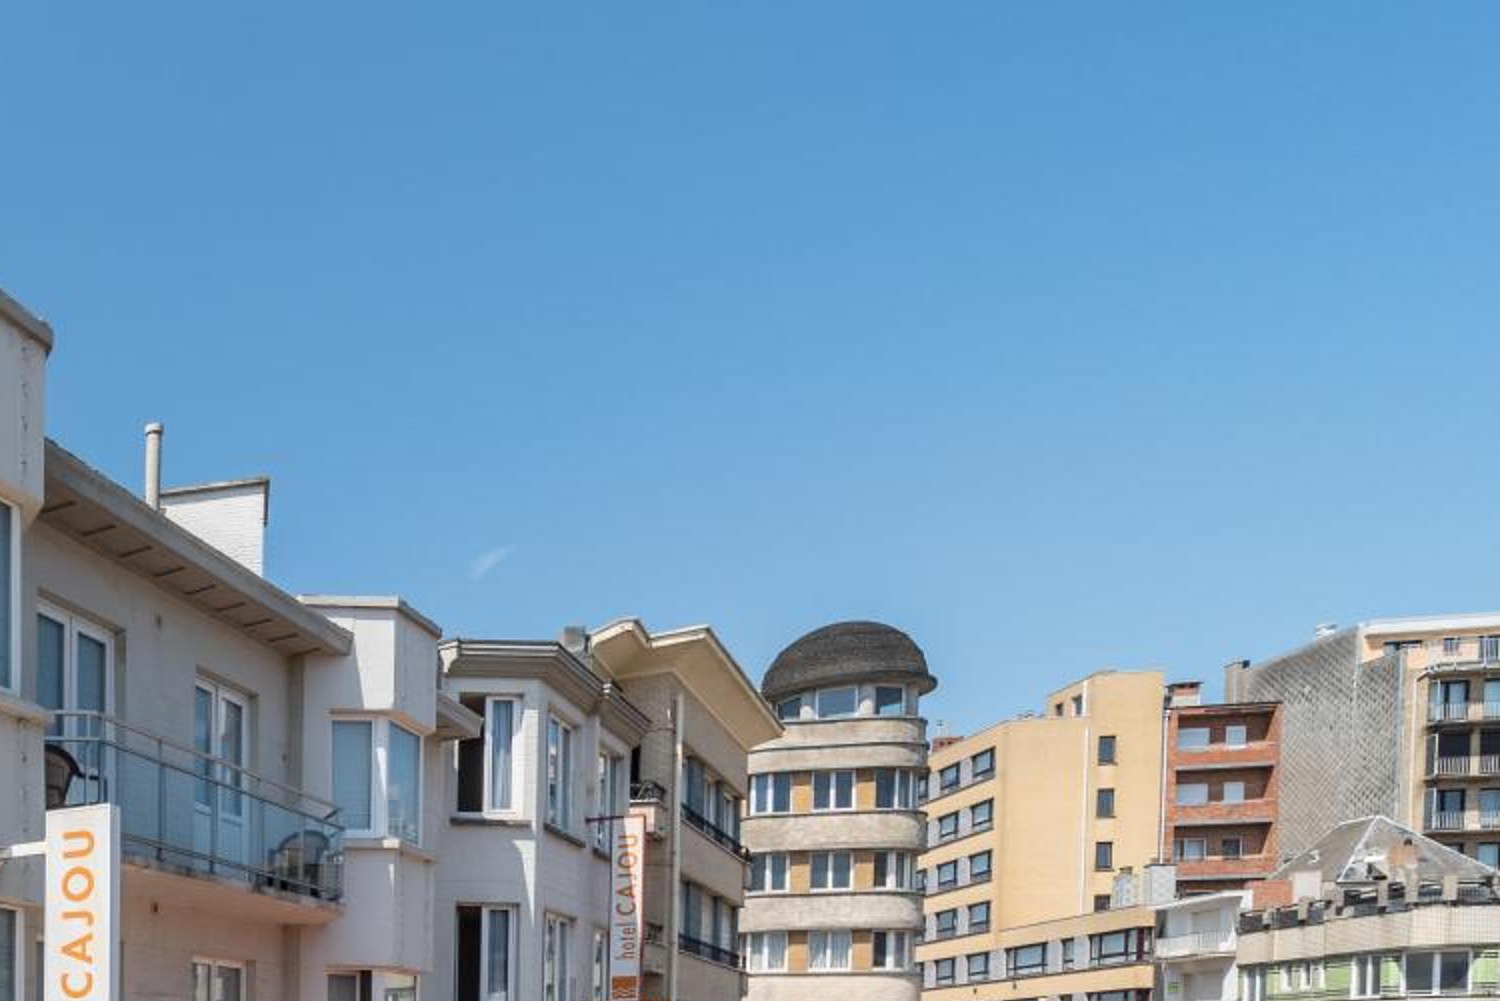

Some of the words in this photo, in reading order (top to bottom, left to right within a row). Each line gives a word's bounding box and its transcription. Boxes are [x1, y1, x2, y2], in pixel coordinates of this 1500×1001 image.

[60, 829, 96, 999] CAJOU
[615, 833, 639, 917] CAJOU
[614, 922, 636, 961] hotel
